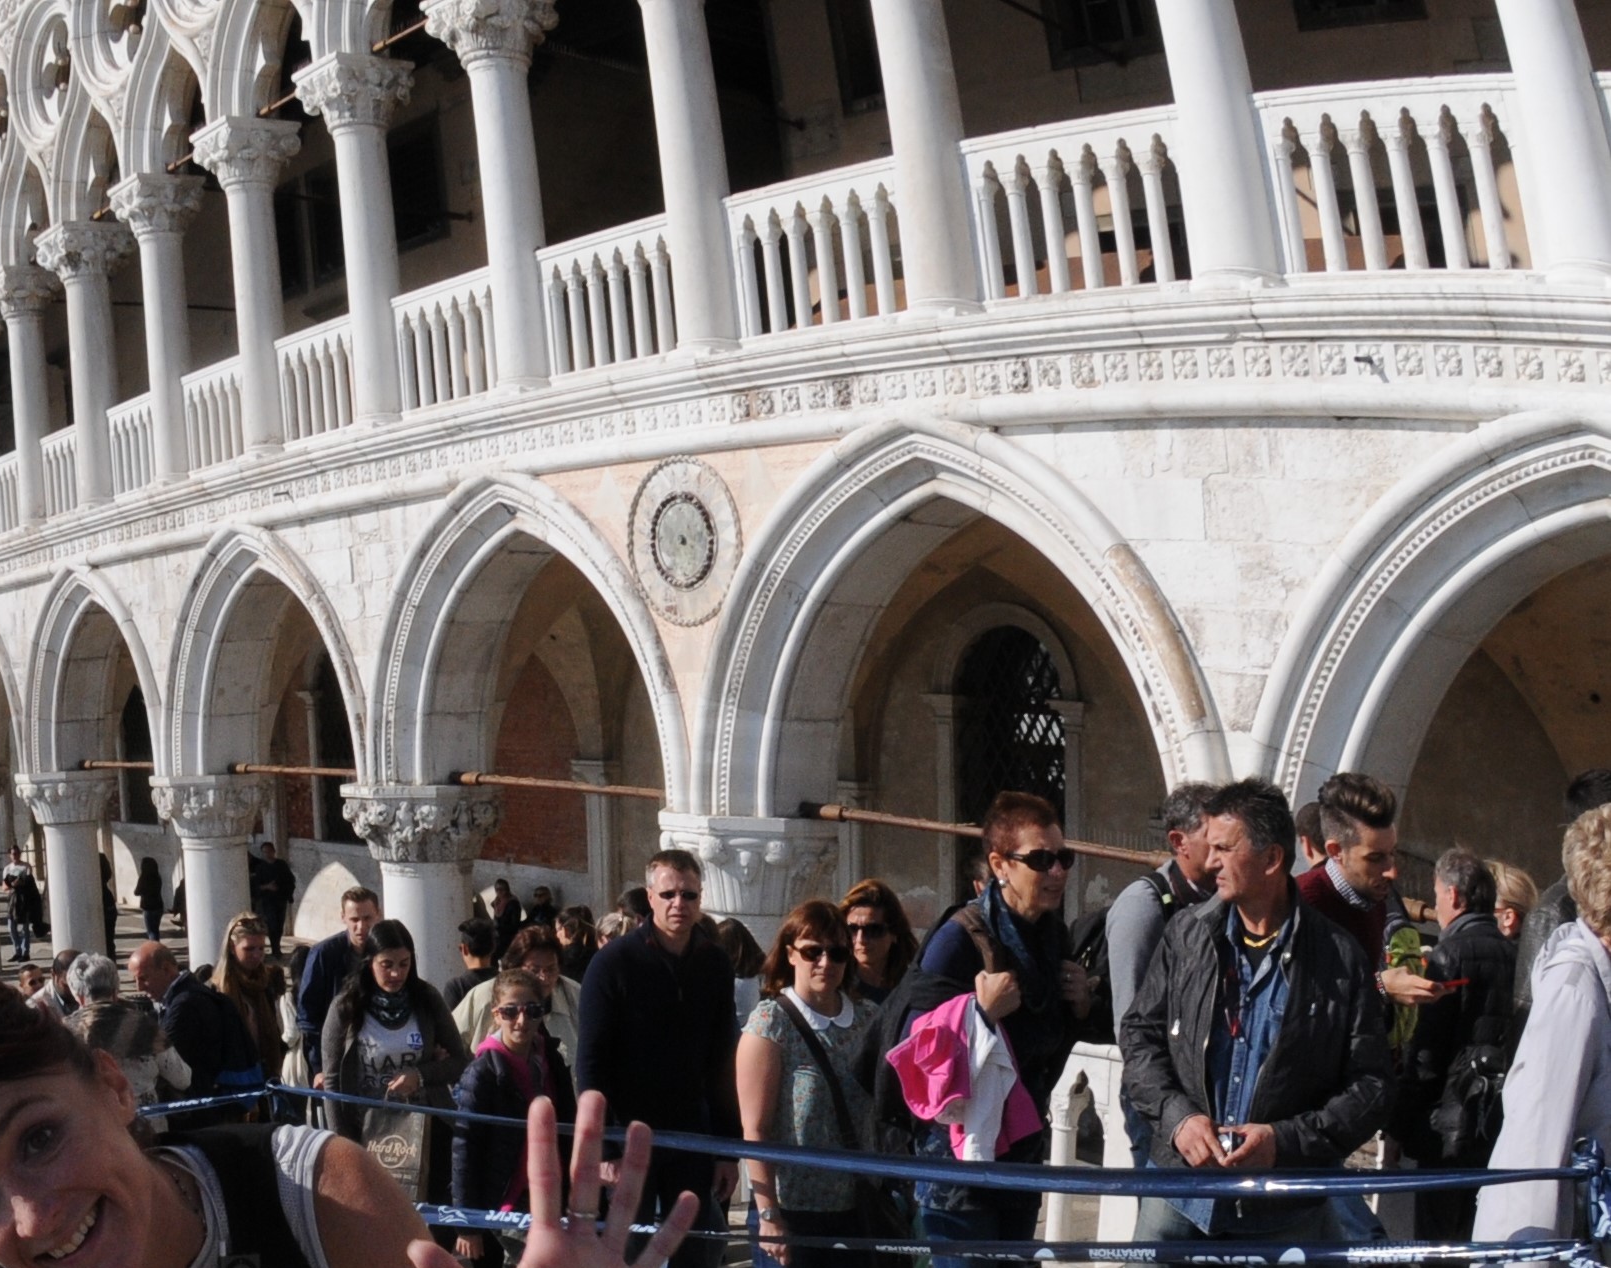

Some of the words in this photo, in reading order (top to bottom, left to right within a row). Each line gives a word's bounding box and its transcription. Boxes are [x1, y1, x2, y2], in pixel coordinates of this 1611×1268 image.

[410, 1033, 421, 1044] 12
[361, 1052, 417, 1074] HAR
[367, 1140, 394, 1154] Hard
[393, 1142, 418, 1158] Rock
[1088, 1248, 1157, 1258] MARATHON
